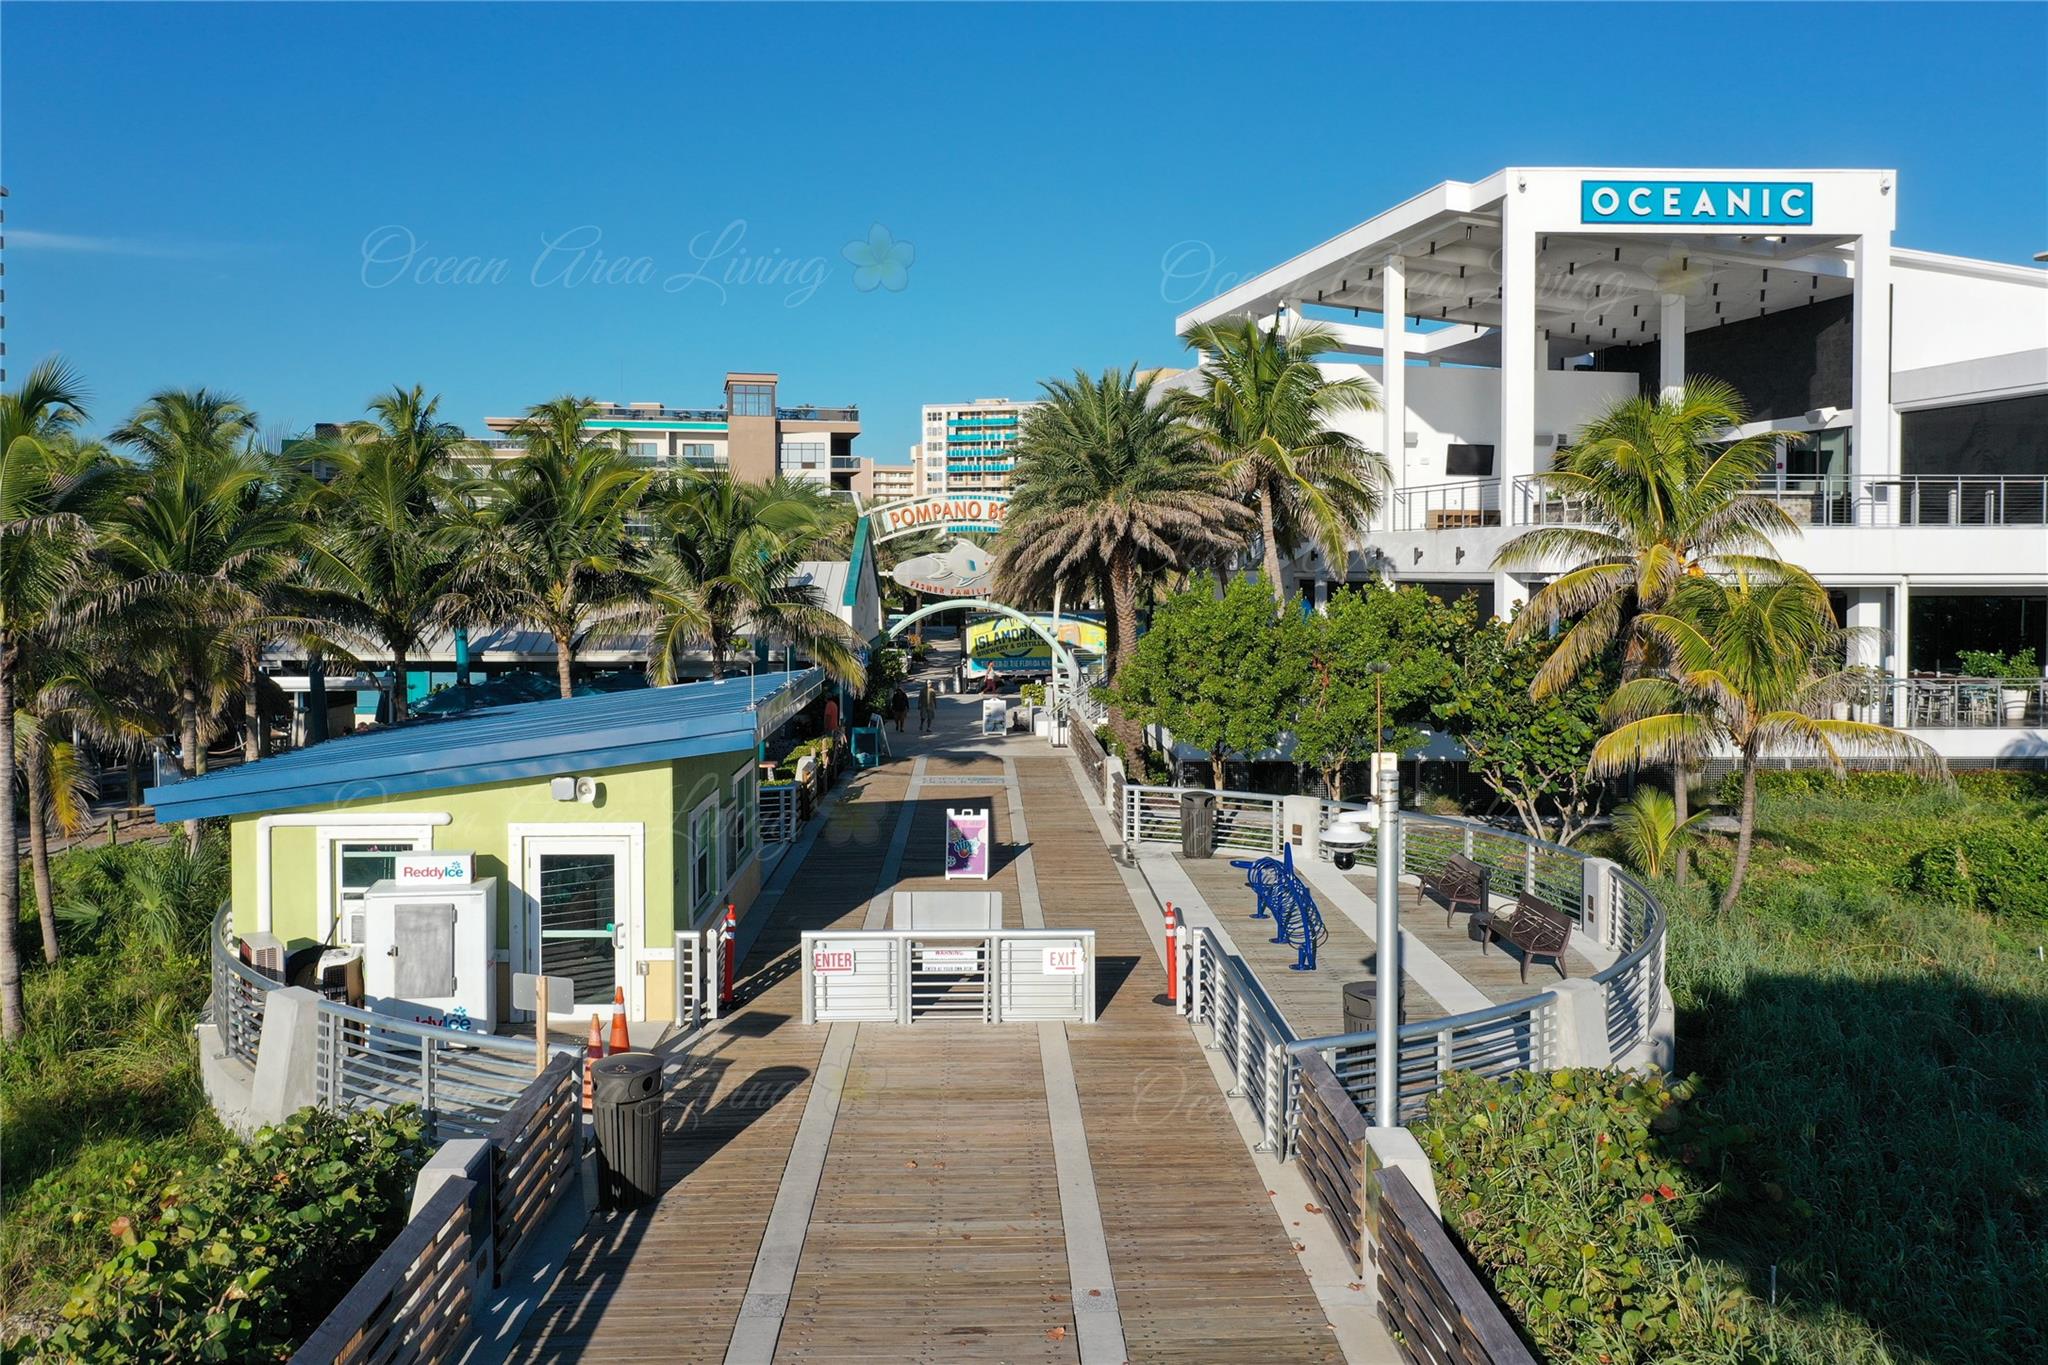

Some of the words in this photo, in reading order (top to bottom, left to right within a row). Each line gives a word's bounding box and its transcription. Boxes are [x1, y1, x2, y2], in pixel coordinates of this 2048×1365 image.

[1591, 187, 1805, 217] OCEANIC
[889, 501, 982, 529] POMPANO
[988, 502, 1007, 522] BE
[950, 586, 988, 596] FAMILY
[974, 627, 1051, 651] ISLAMORA
[815, 952, 852, 968] ENTER
[1049, 950, 1077, 967] EXIT
